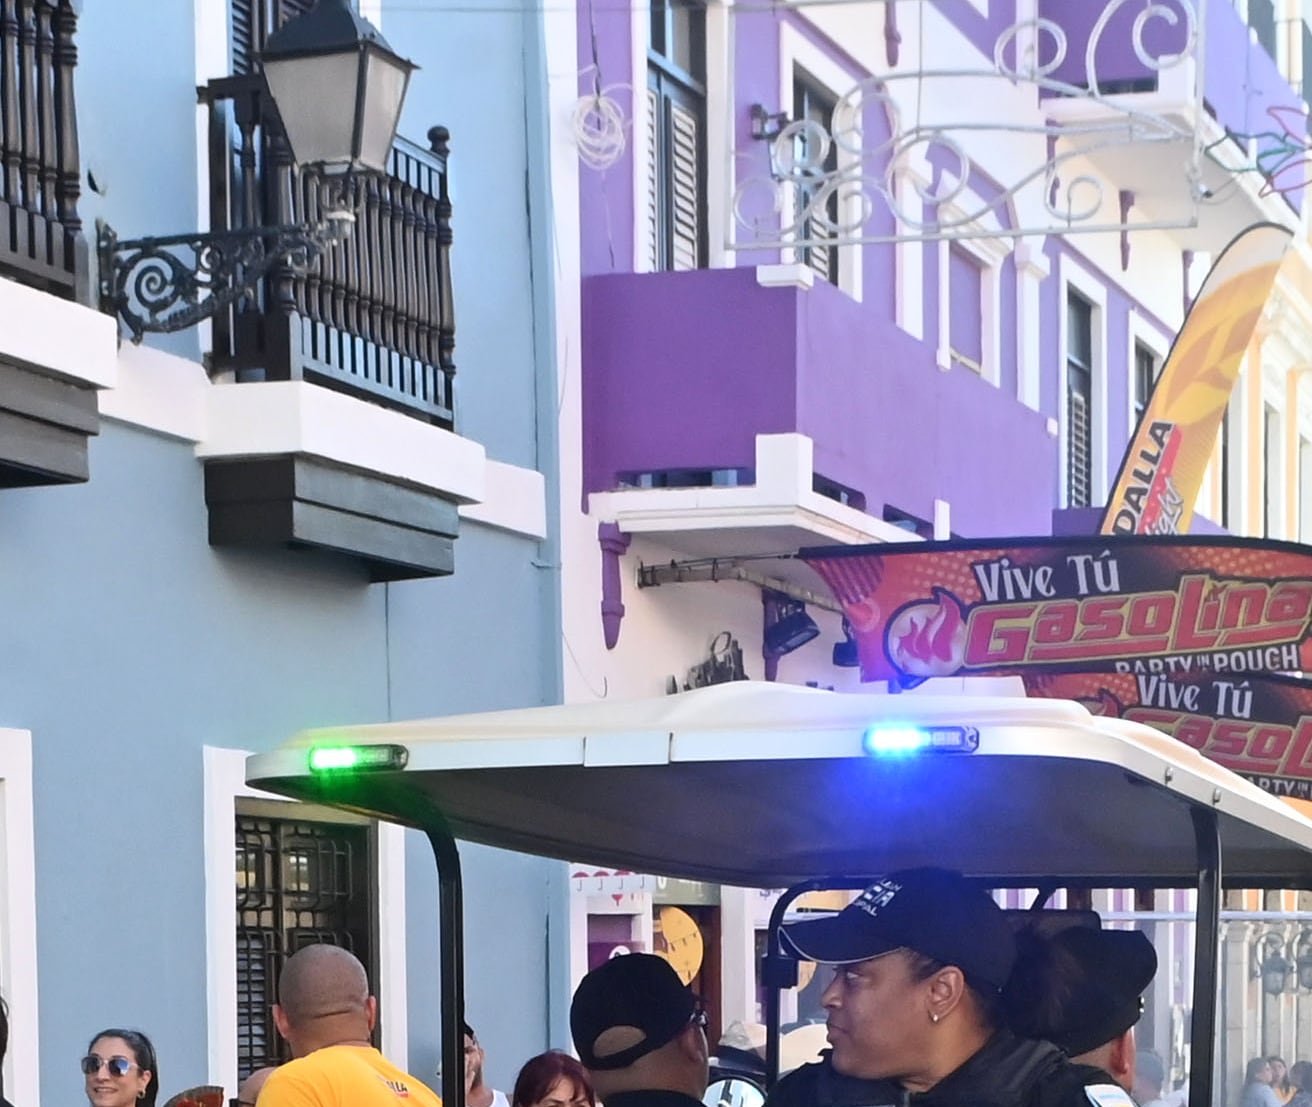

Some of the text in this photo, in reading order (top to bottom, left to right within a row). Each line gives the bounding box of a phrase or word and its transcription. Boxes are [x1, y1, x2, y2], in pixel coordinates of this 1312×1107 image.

[974, 549, 1120, 602] Vive Tú
[1196, 653, 1210, 667] IN
[1213, 644, 1299, 673] POUCH
[1137, 672, 1254, 719] Vive Tú
